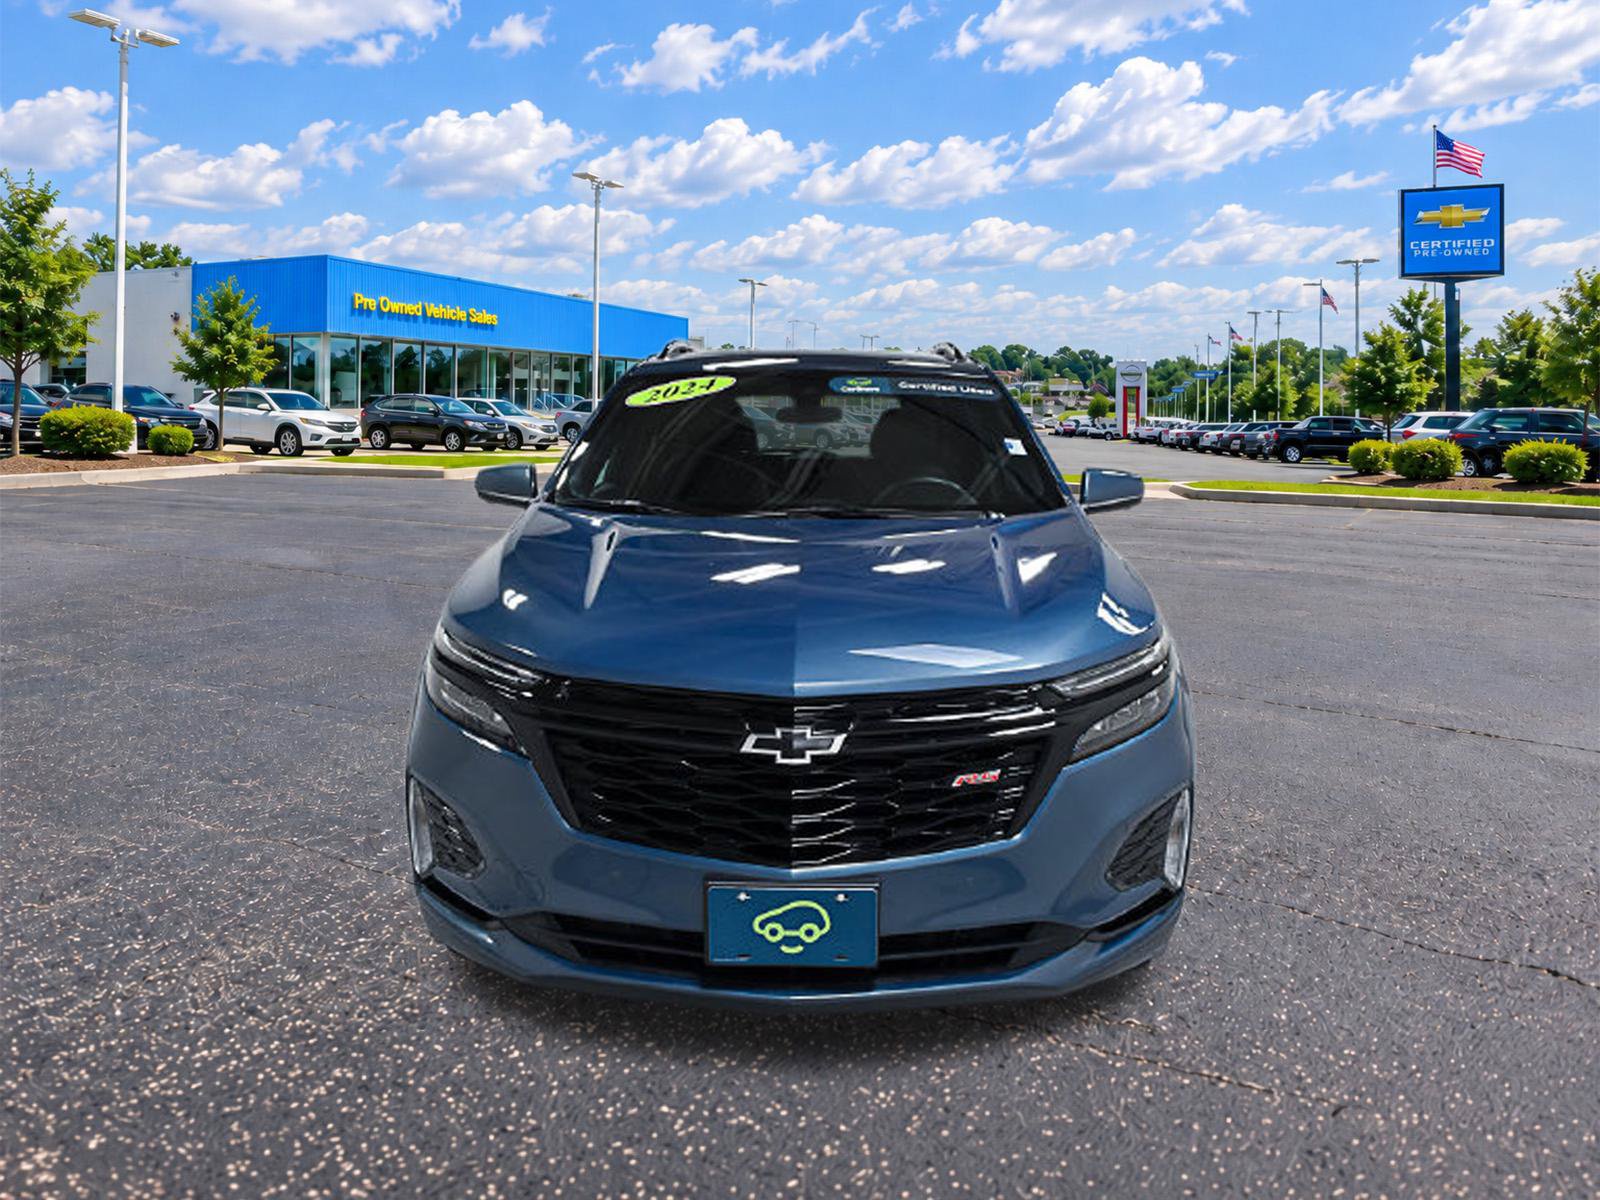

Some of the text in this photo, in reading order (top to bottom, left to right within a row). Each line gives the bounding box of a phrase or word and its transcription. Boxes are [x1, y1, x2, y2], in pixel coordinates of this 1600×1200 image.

[1410, 238, 1495, 249] CERTIFIED
[1413, 248, 1490, 257] PRE-OWNED
[353, 293, 498, 325] Pre Owned Vehicle Sales
[644, 378, 717, 403] 2024
